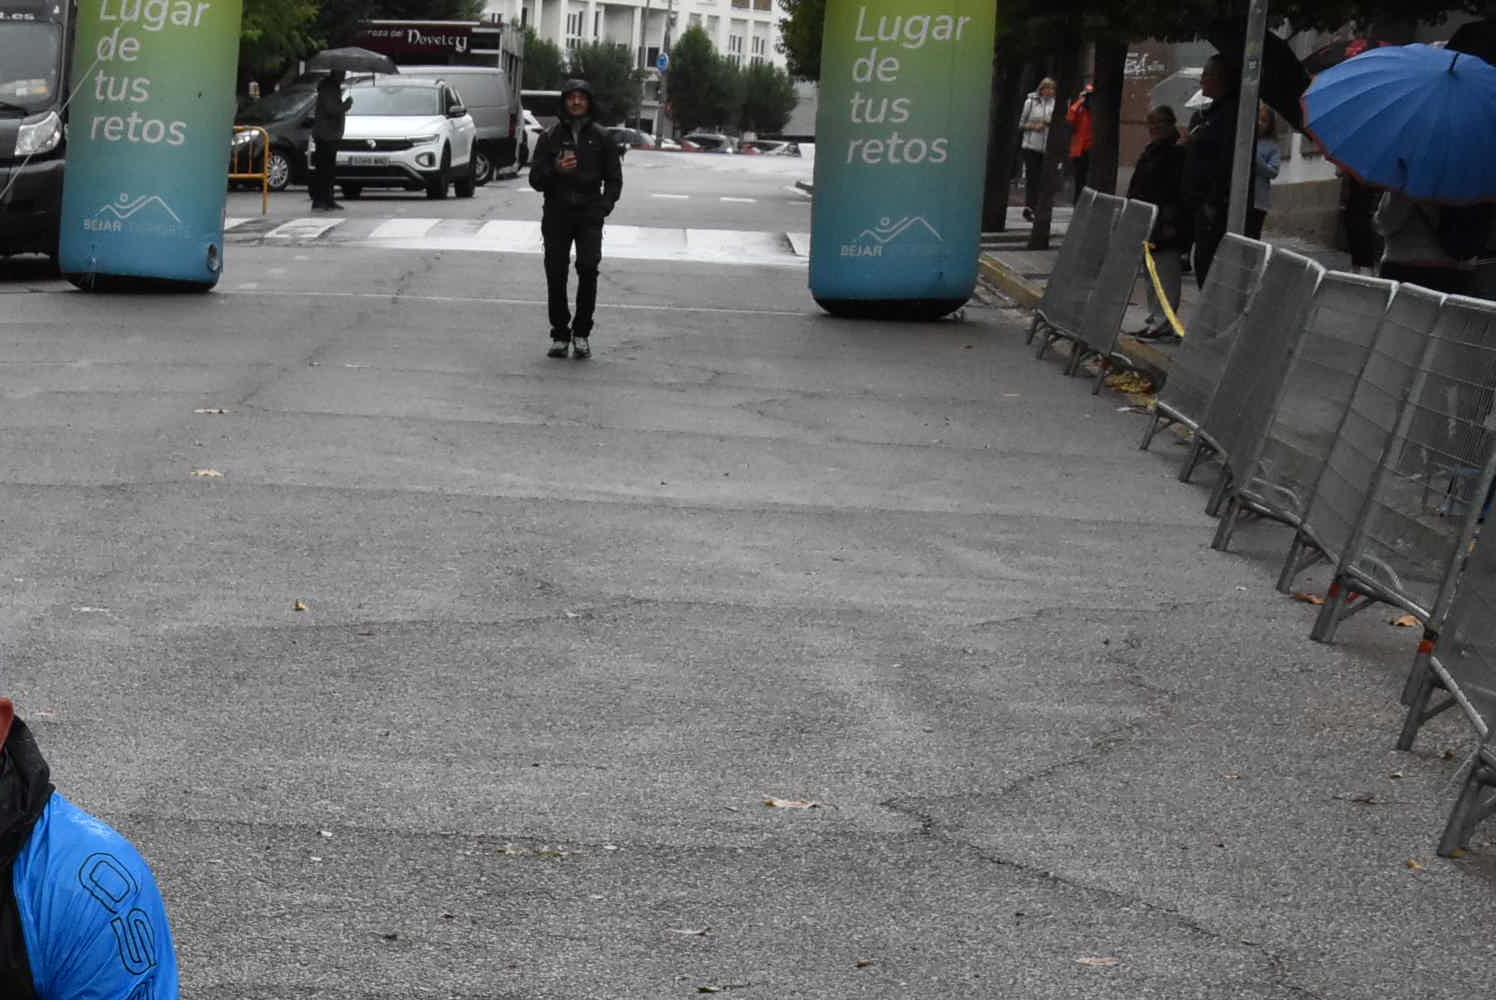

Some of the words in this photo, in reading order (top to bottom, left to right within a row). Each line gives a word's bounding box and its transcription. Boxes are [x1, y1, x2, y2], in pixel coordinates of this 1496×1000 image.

[99, 0, 210, 31] Lugar
[855, 7, 971, 49] Lugar
[97, 27, 140, 61] de
[852, 47, 899, 82] de
[94, 69, 151, 103] tus
[850, 91, 911, 123] tus
[91, 111, 187, 145] retos
[846, 131, 949, 164] retos
